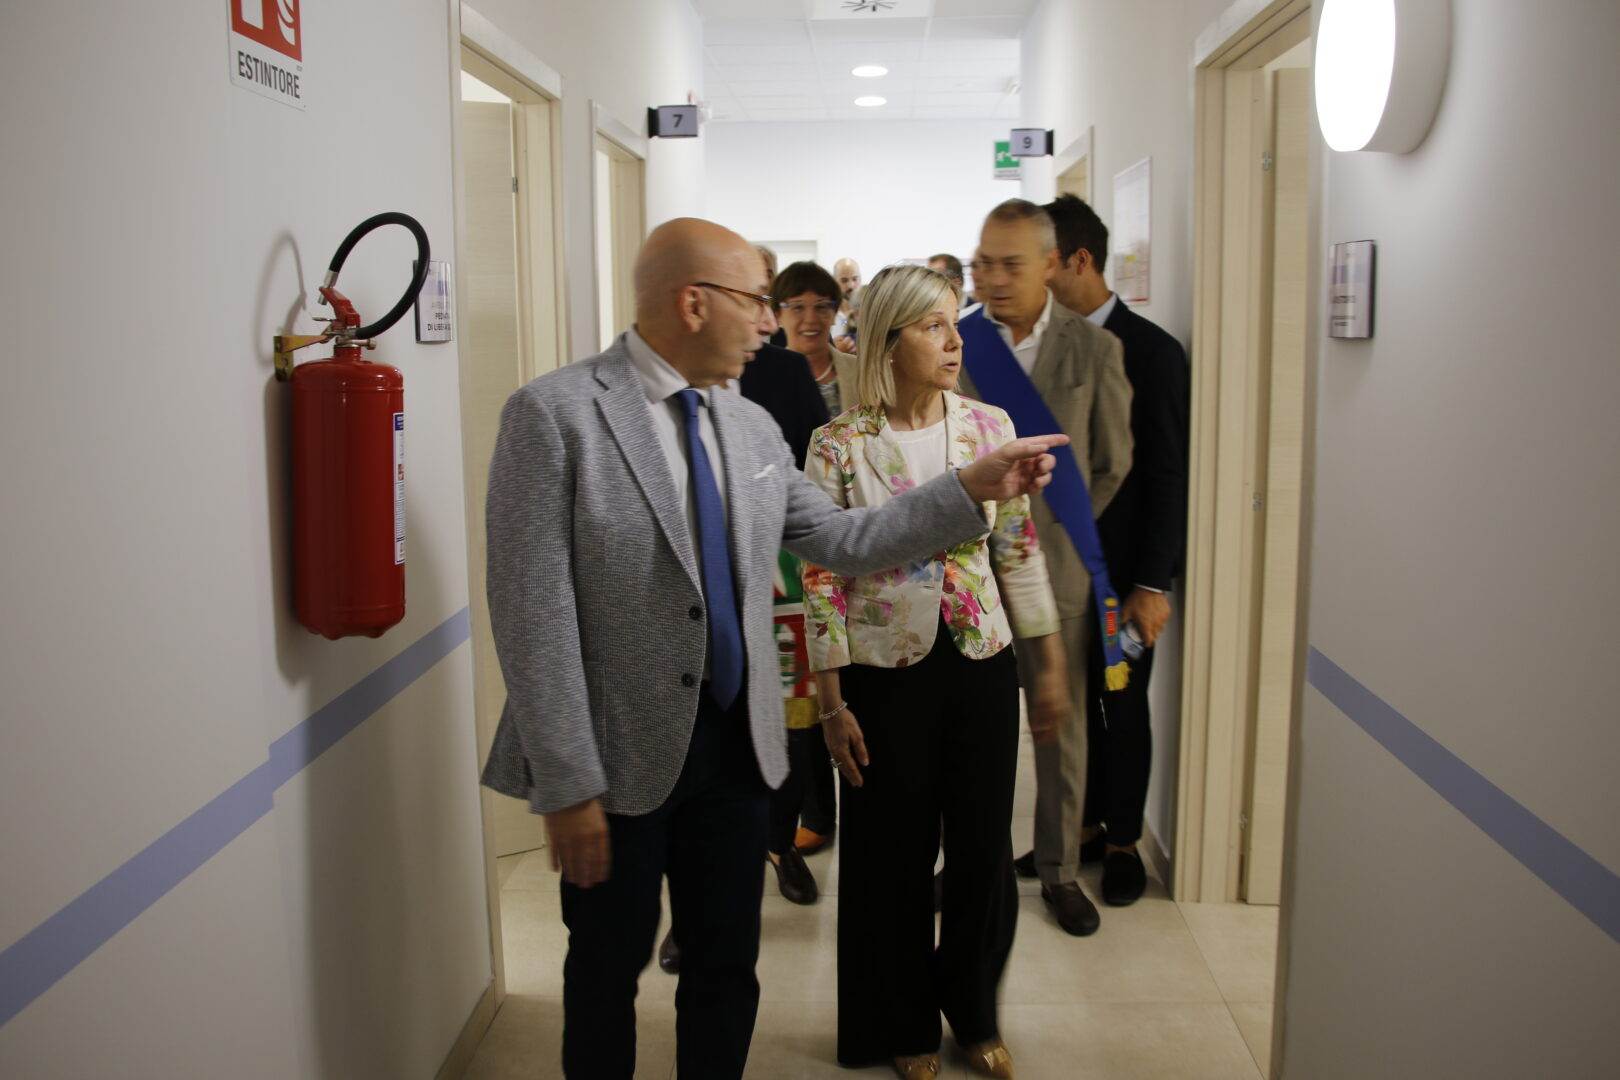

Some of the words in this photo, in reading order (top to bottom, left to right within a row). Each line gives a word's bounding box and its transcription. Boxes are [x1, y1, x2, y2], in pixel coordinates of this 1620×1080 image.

[238, 50, 301, 99] ESTINTORE
[673, 114, 683, 128] 7
[1023, 136, 1032, 149] 9
